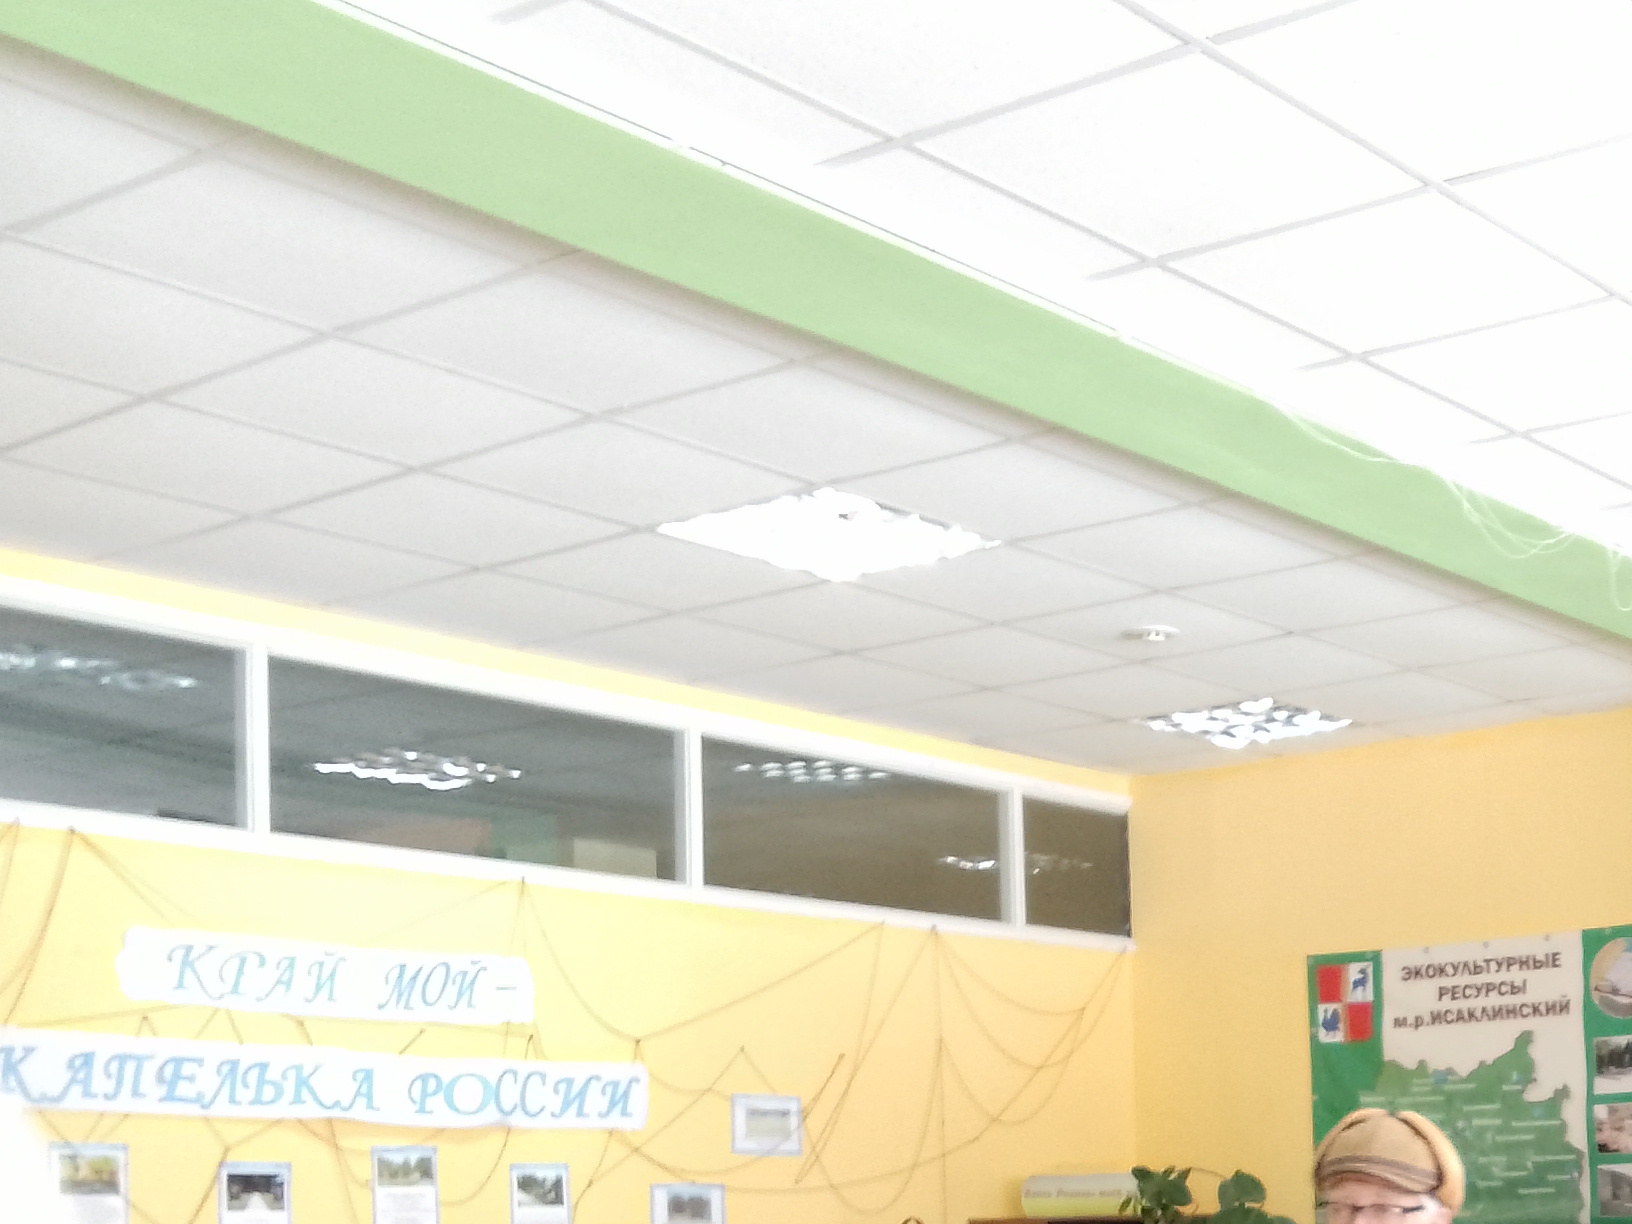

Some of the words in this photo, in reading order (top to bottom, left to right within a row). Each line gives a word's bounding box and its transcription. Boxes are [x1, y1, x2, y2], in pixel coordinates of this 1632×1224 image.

[167, 944, 347, 1003] КРАЙ
[377, 959, 488, 1010] МОЙ
[1400, 951, 1562, 982] ЭКОКУЛЬТУРНЫЕ
[1438, 978, 1528, 1002] РЕСУРСЫ
[0, 1045, 381, 1111] КАПЕЛЬКА
[407, 1068, 641, 1118] РОССИИ
